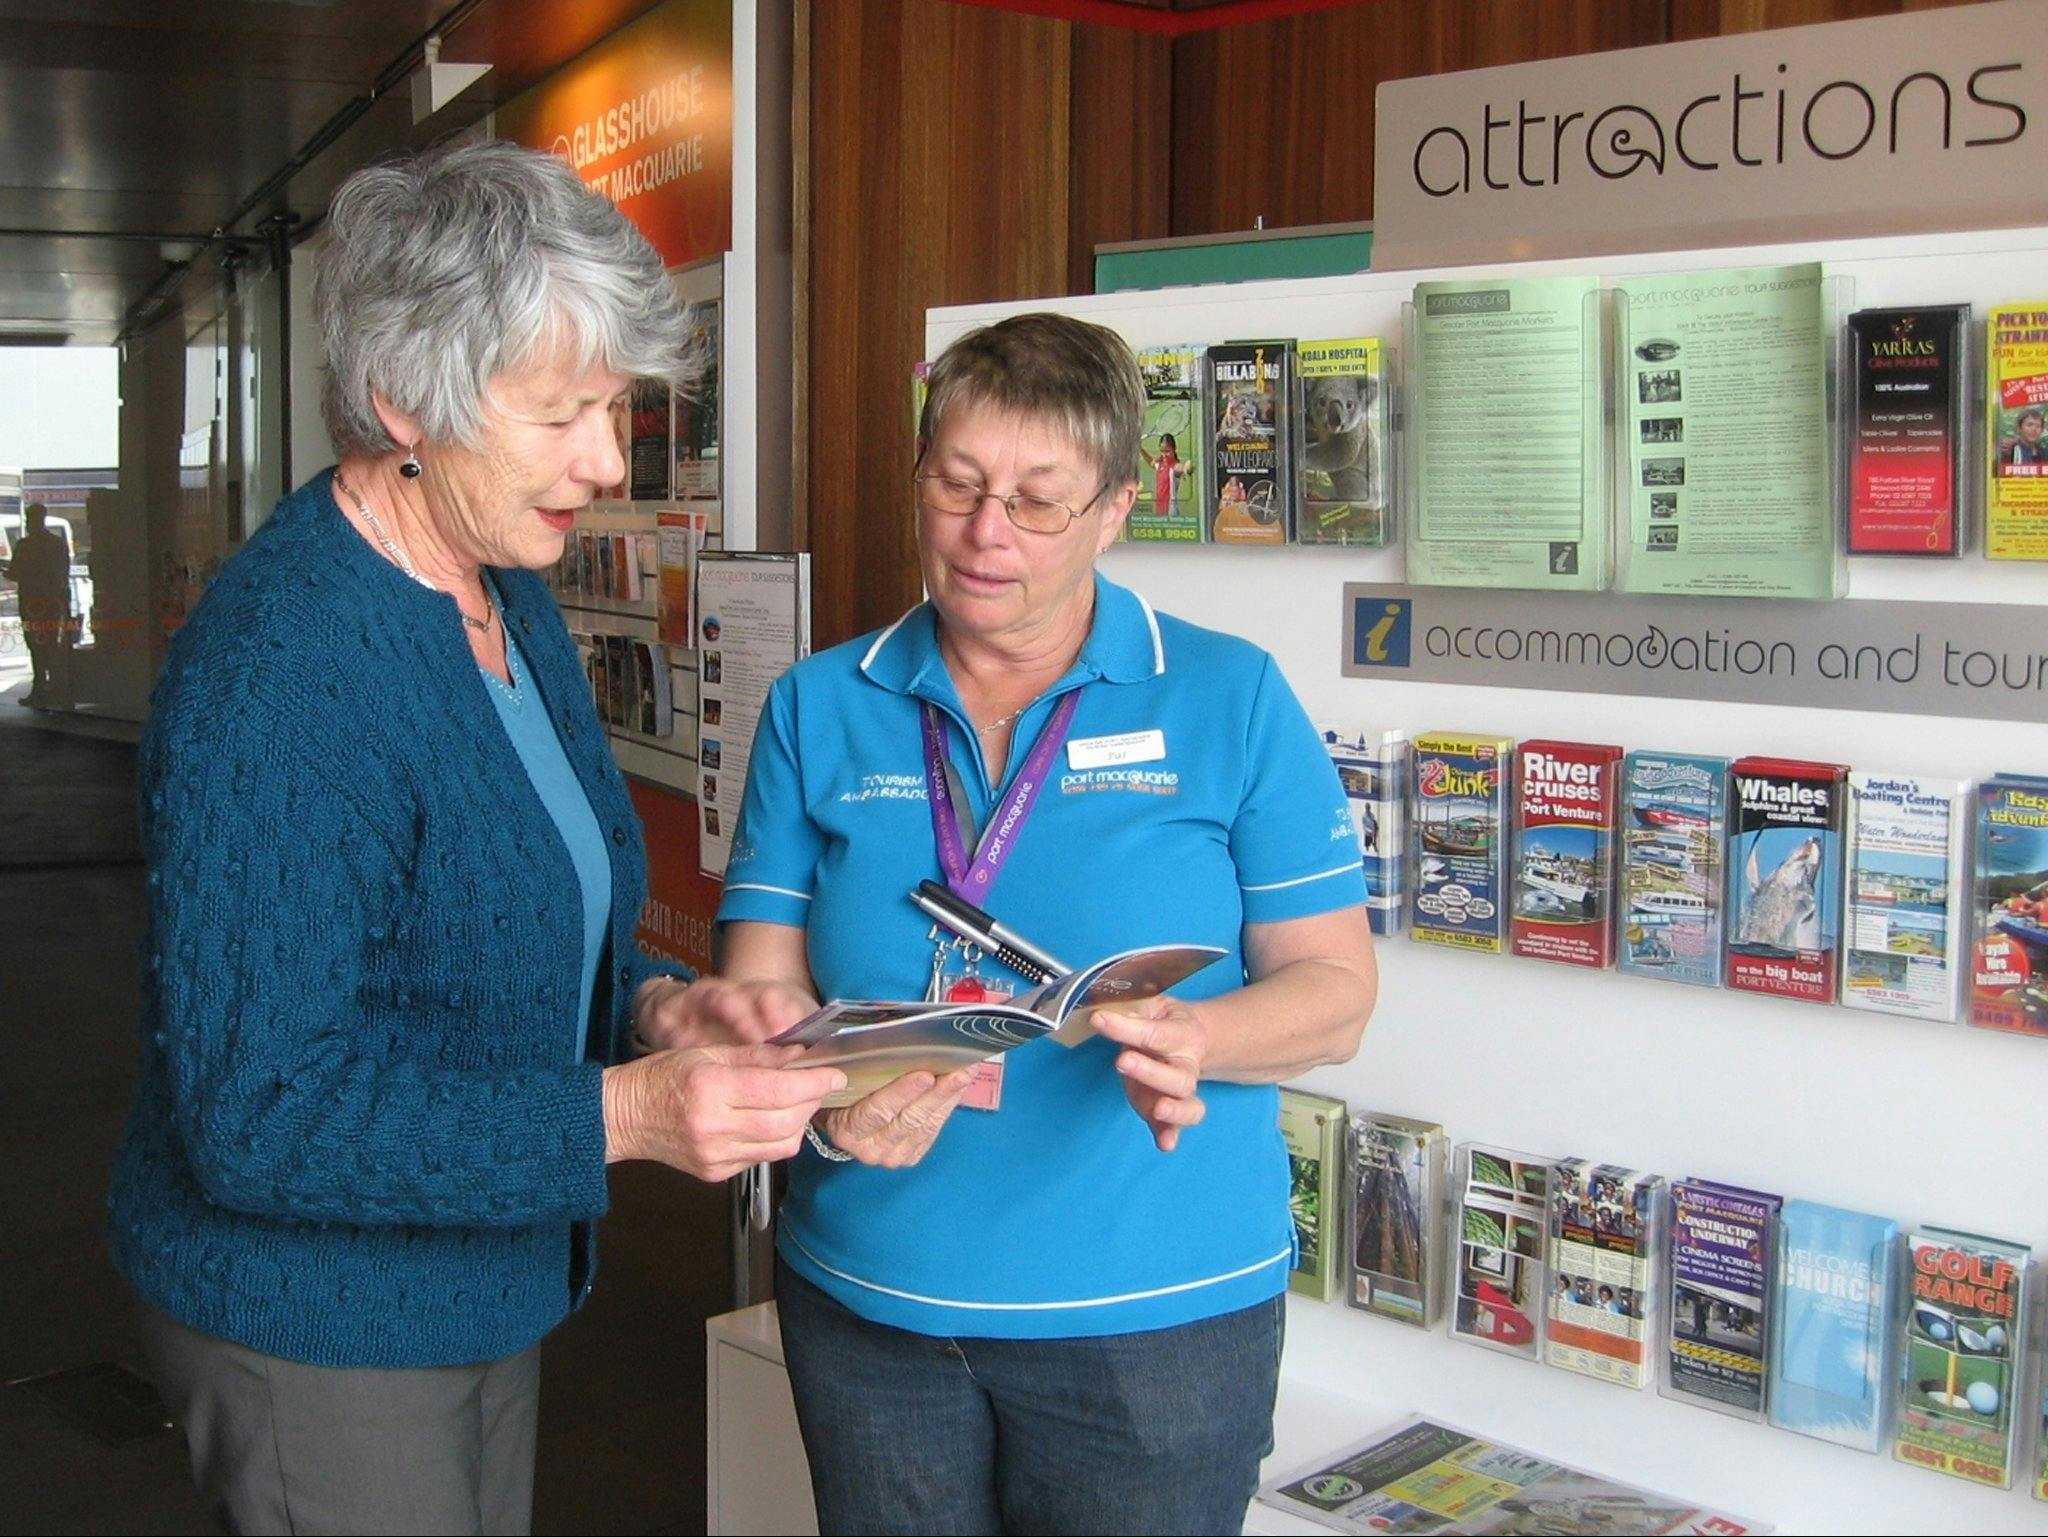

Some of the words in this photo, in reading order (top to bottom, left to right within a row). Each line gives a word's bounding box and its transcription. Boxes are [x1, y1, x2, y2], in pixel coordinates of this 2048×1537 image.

[573, 64, 703, 170] GLASSHOUSE
[1414, 63, 2027, 197] attractions
[611, 134, 703, 202] MACQUARIE
[1329, 348, 1367, 359] HOSPITAL
[1871, 338, 1936, 356] YARRAS
[1426, 624, 1796, 677] accommodation
[1817, 633, 1920, 684] and
[862, 774, 924, 787] TOURISM
[1061, 770, 1094, 790] port
[1096, 768, 1179, 786] macquarie
[1523, 752, 1602, 784] River
[1433, 763, 1491, 799] Junk
[1523, 779, 1602, 802] cruises
[1735, 776, 1830, 808] Whales,
[1866, 778, 1920, 793] Jordan's
[840, 787, 929, 802] AMBASSADO
[1852, 786, 1904, 807] Boating
[1905, 792, 1950, 808] Centre
[1521, 800, 1550, 816] Port
[1552, 803, 1603, 822] Venture
[1766, 811, 1801, 822] coastal
[1781, 803, 1789, 812] &
[1790, 805, 1817, 815] great
[987, 837, 1006, 865] port
[999, 782, 1034, 839] macquarie
[1736, 974, 1768, 988] PORT
[1768, 978, 1824, 996] VENTURE
[1749, 966, 1764, 976] the
[1765, 963, 1788, 981] big
[1791, 967, 1824, 984] boat
[1678, 1214, 1758, 1240] CONSTRUCTION
[1689, 1226, 1750, 1250] UNDERWAY
[1681, 1244, 1720, 1262] CINEMA
[1720, 1254, 1763, 1273] SCREENS
[1779, 1245, 1870, 1282] WELCOME
[1914, 1244, 2017, 1291] GOLF
[1780, 1262, 1881, 1308] CHURCH
[1911, 1272, 2015, 1319] RANGE
